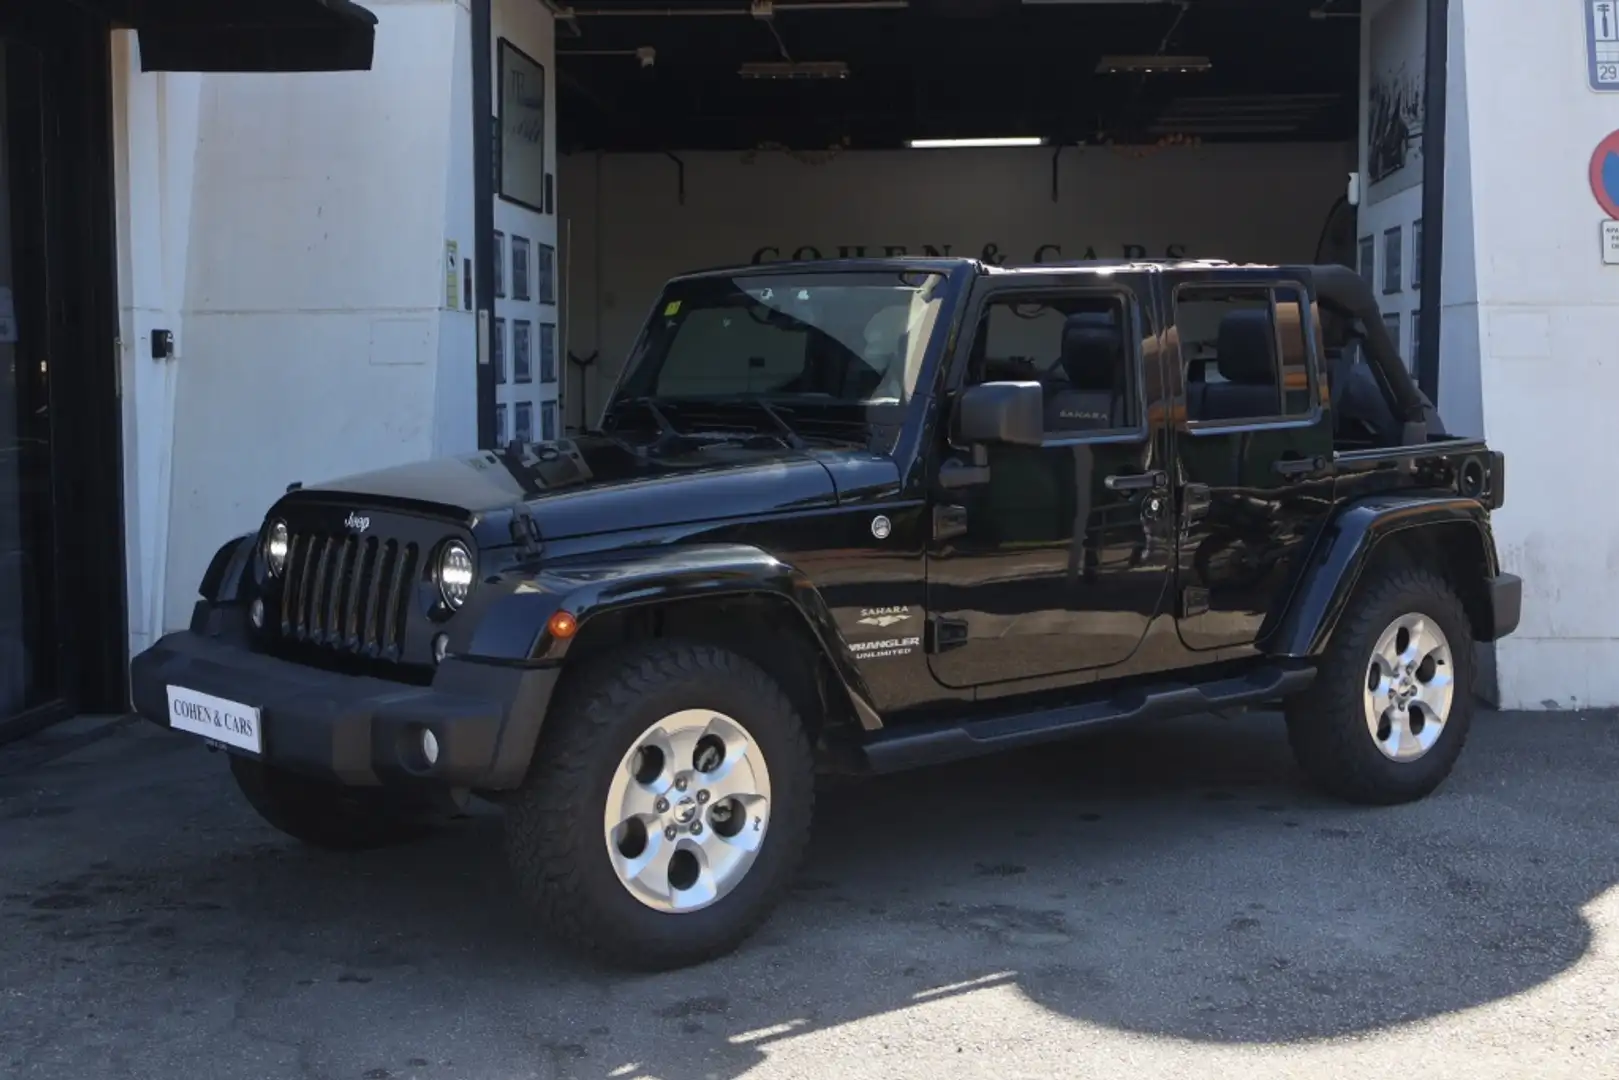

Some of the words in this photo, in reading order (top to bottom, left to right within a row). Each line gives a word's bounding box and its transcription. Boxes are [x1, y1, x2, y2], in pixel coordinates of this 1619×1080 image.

[1599, 65, 1617, 80] 29
[344, 512, 370, 532] Jeep
[861, 606, 908, 616] SAHARA
[848, 637, 919, 651] WRANGLER
[856, 649, 910, 658] UNLIMITED
[174, 699, 211, 722] COHEN
[213, 709, 223, 727] &
[225, 713, 252, 736] CARS
